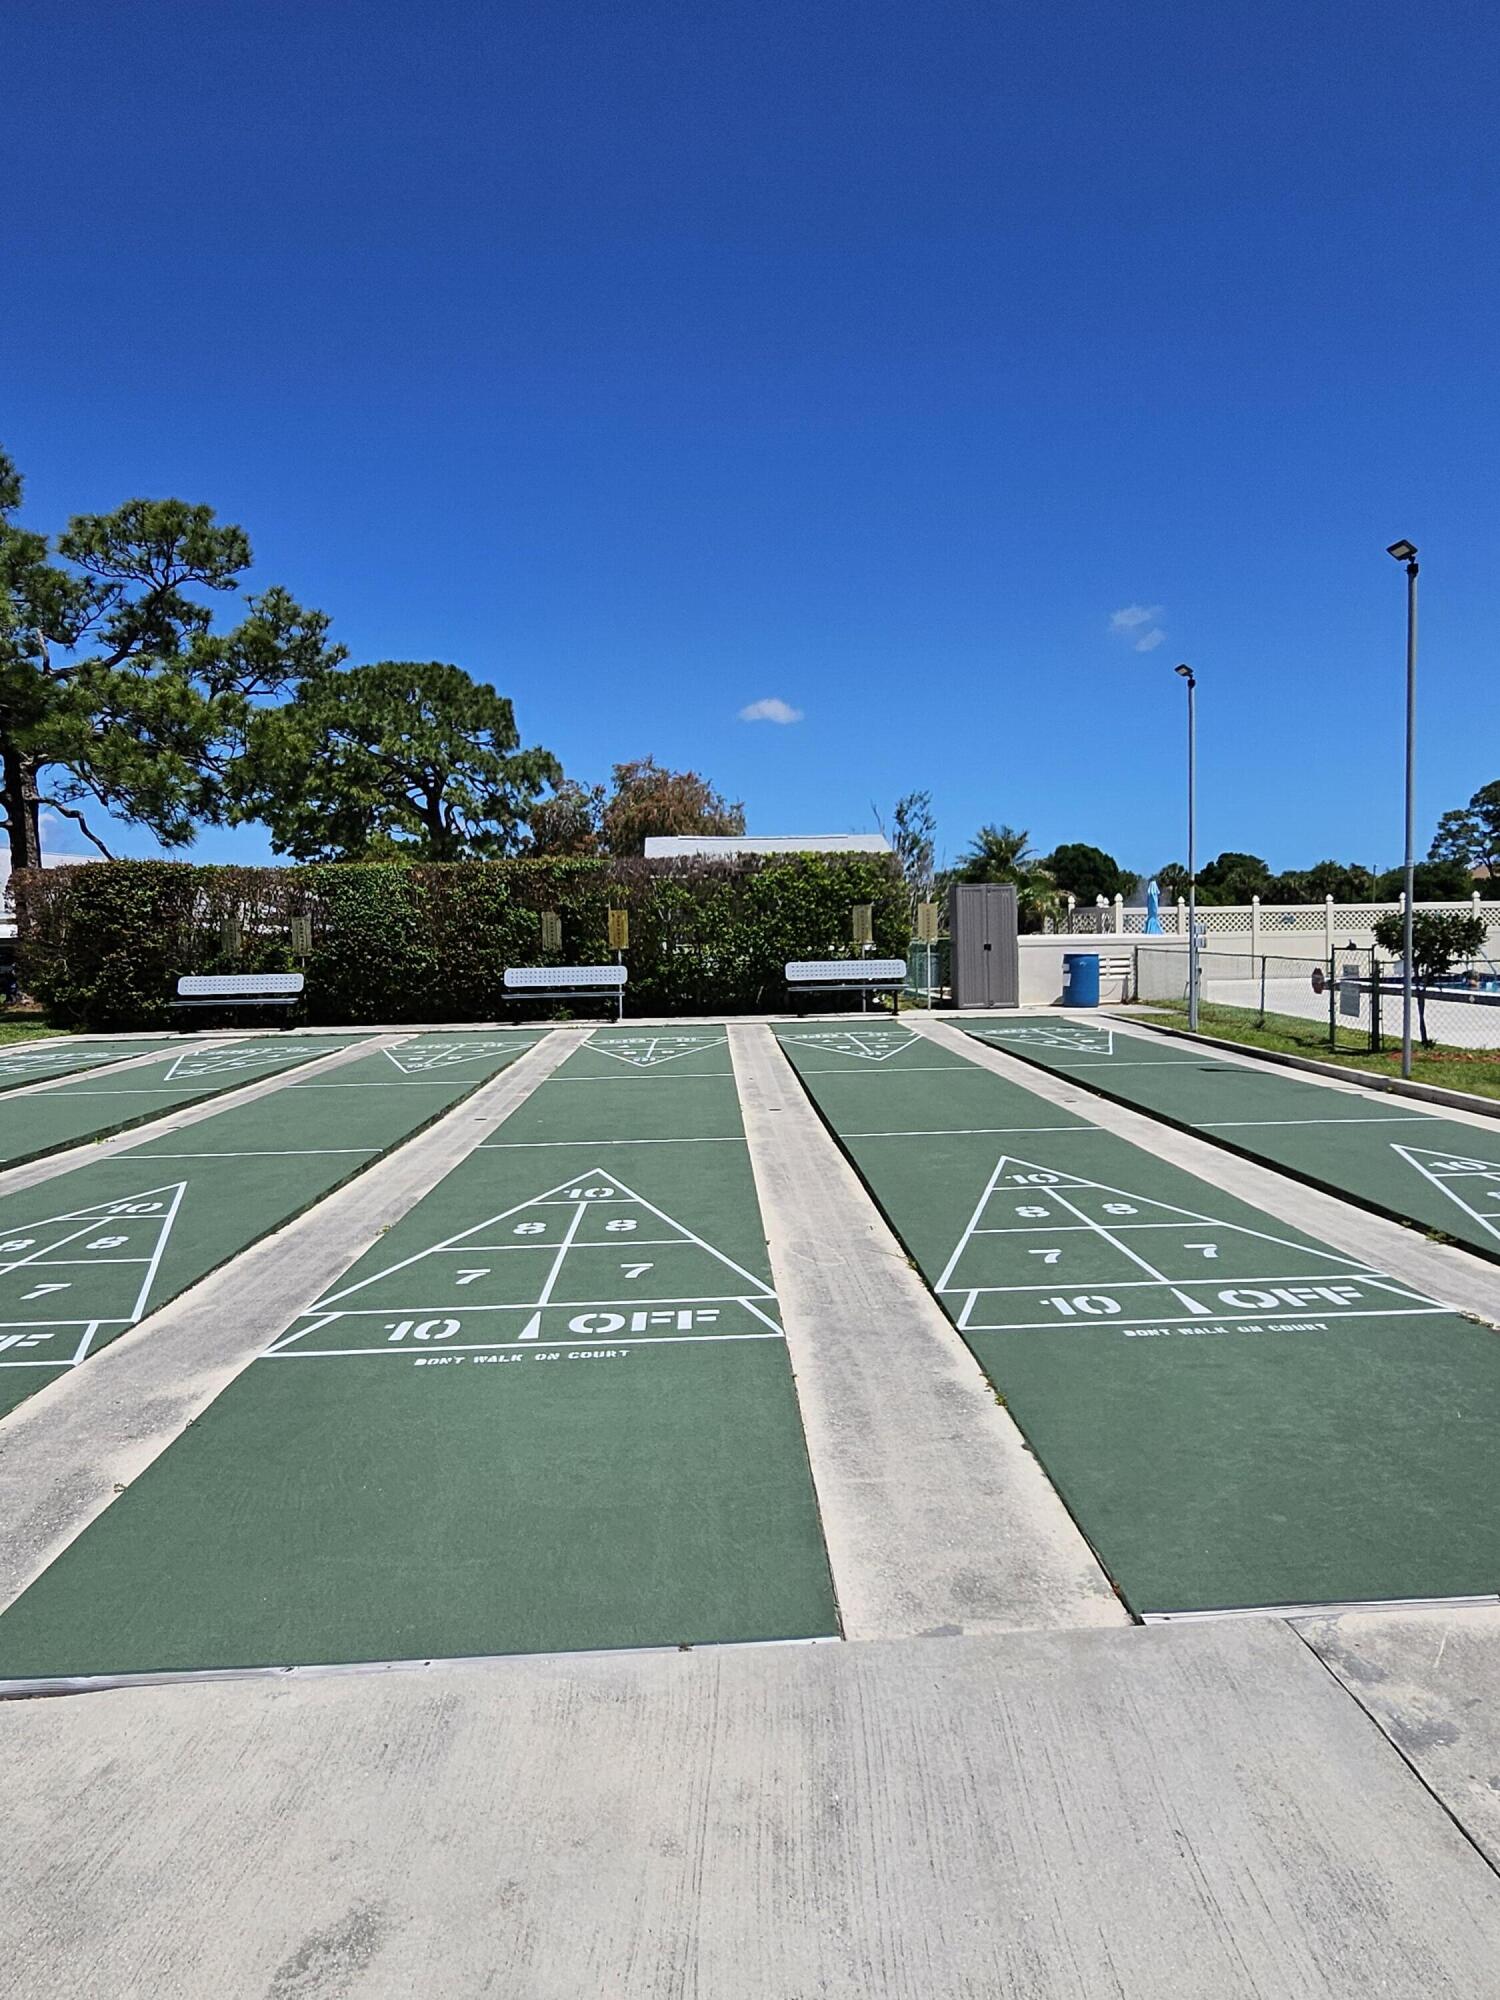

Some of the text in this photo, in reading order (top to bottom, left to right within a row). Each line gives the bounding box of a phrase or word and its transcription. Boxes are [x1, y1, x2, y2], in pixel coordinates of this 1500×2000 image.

[1428, 1161, 1488, 1170] 10
[1004, 1173, 1059, 1184] 10
[563, 1187, 616, 1199] 10
[107, 1202, 164, 1214] 10
[1015, 1203, 1138, 1218] 8 8
[513, 1219, 638, 1235] 8 8
[85, 1235, 130, 1250] 8
[1028, 1243, 1219, 1264] 7 7
[455, 1262, 654, 1285] 7 7
[19, 1282, 73, 1300] 7
[1039, 1285, 1364, 1316] 10 OFF
[384, 1309, 720, 1341] 10 OFF
[1176, 1326, 1230, 1336] WALK
[1236, 1325, 1264, 1333] ON
[1267, 1323, 1329, 1332] COURT
[473, 1353, 523, 1364] WALK
[534, 1352, 560, 1361] ON
[567, 1349, 630, 1360] COURT
